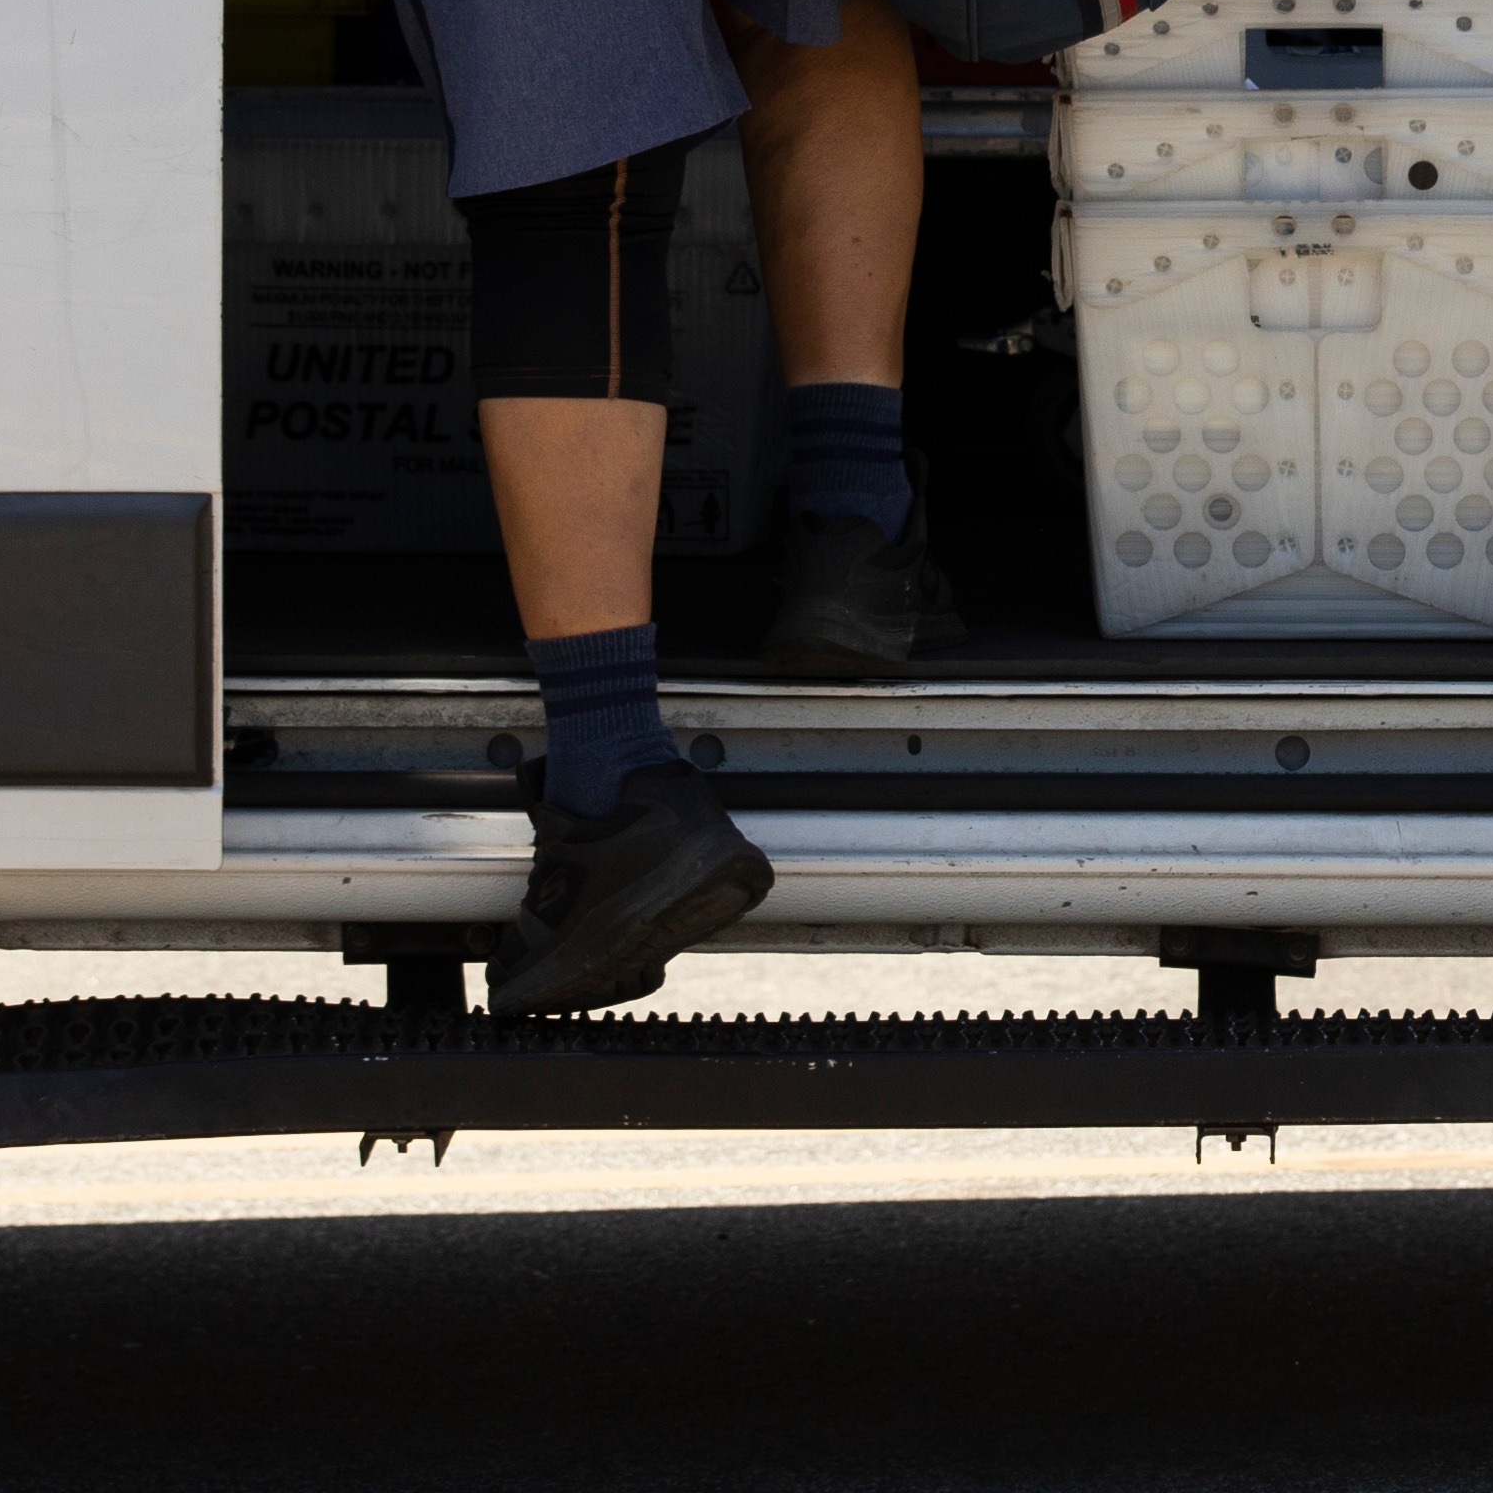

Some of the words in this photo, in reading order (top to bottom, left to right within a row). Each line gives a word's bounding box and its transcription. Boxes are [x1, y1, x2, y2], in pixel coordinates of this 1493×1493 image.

[272, 259, 383, 280] WARNING
[404, 261, 453, 281] NOT
[265, 342, 457, 385] UNITED
[244, 398, 452, 443] POSTAL
[391, 455, 434, 474] FOR
